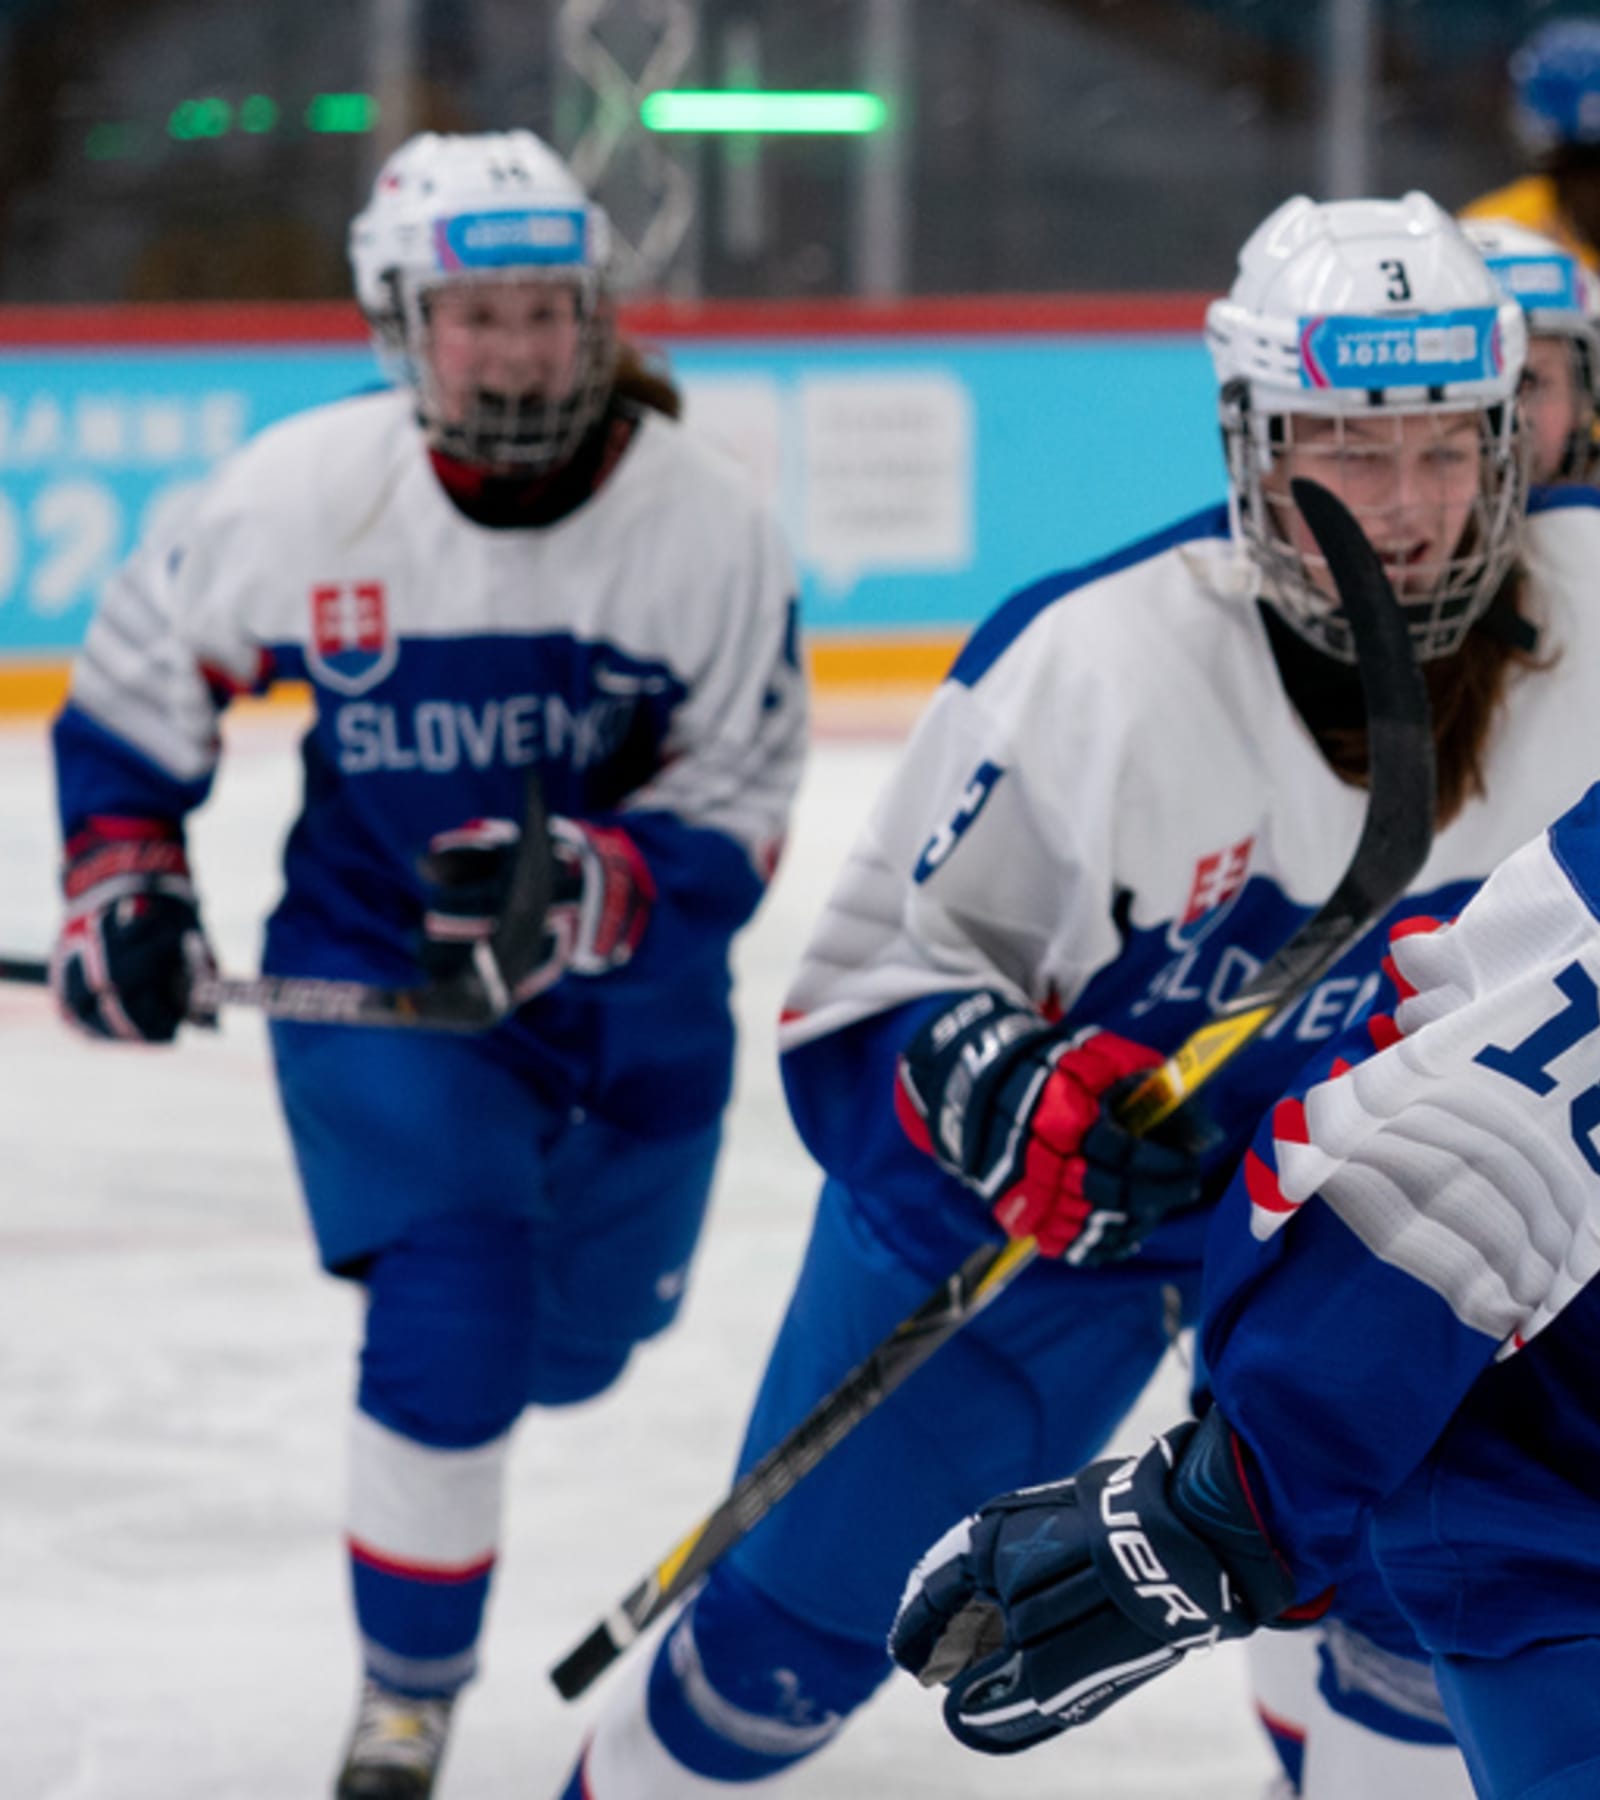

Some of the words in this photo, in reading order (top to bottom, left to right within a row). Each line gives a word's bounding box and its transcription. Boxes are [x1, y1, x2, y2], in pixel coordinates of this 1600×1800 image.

[1380, 259, 1412, 301] 3
[0, 390, 247, 466] ANNE
[912, 760, 1006, 885] 3
